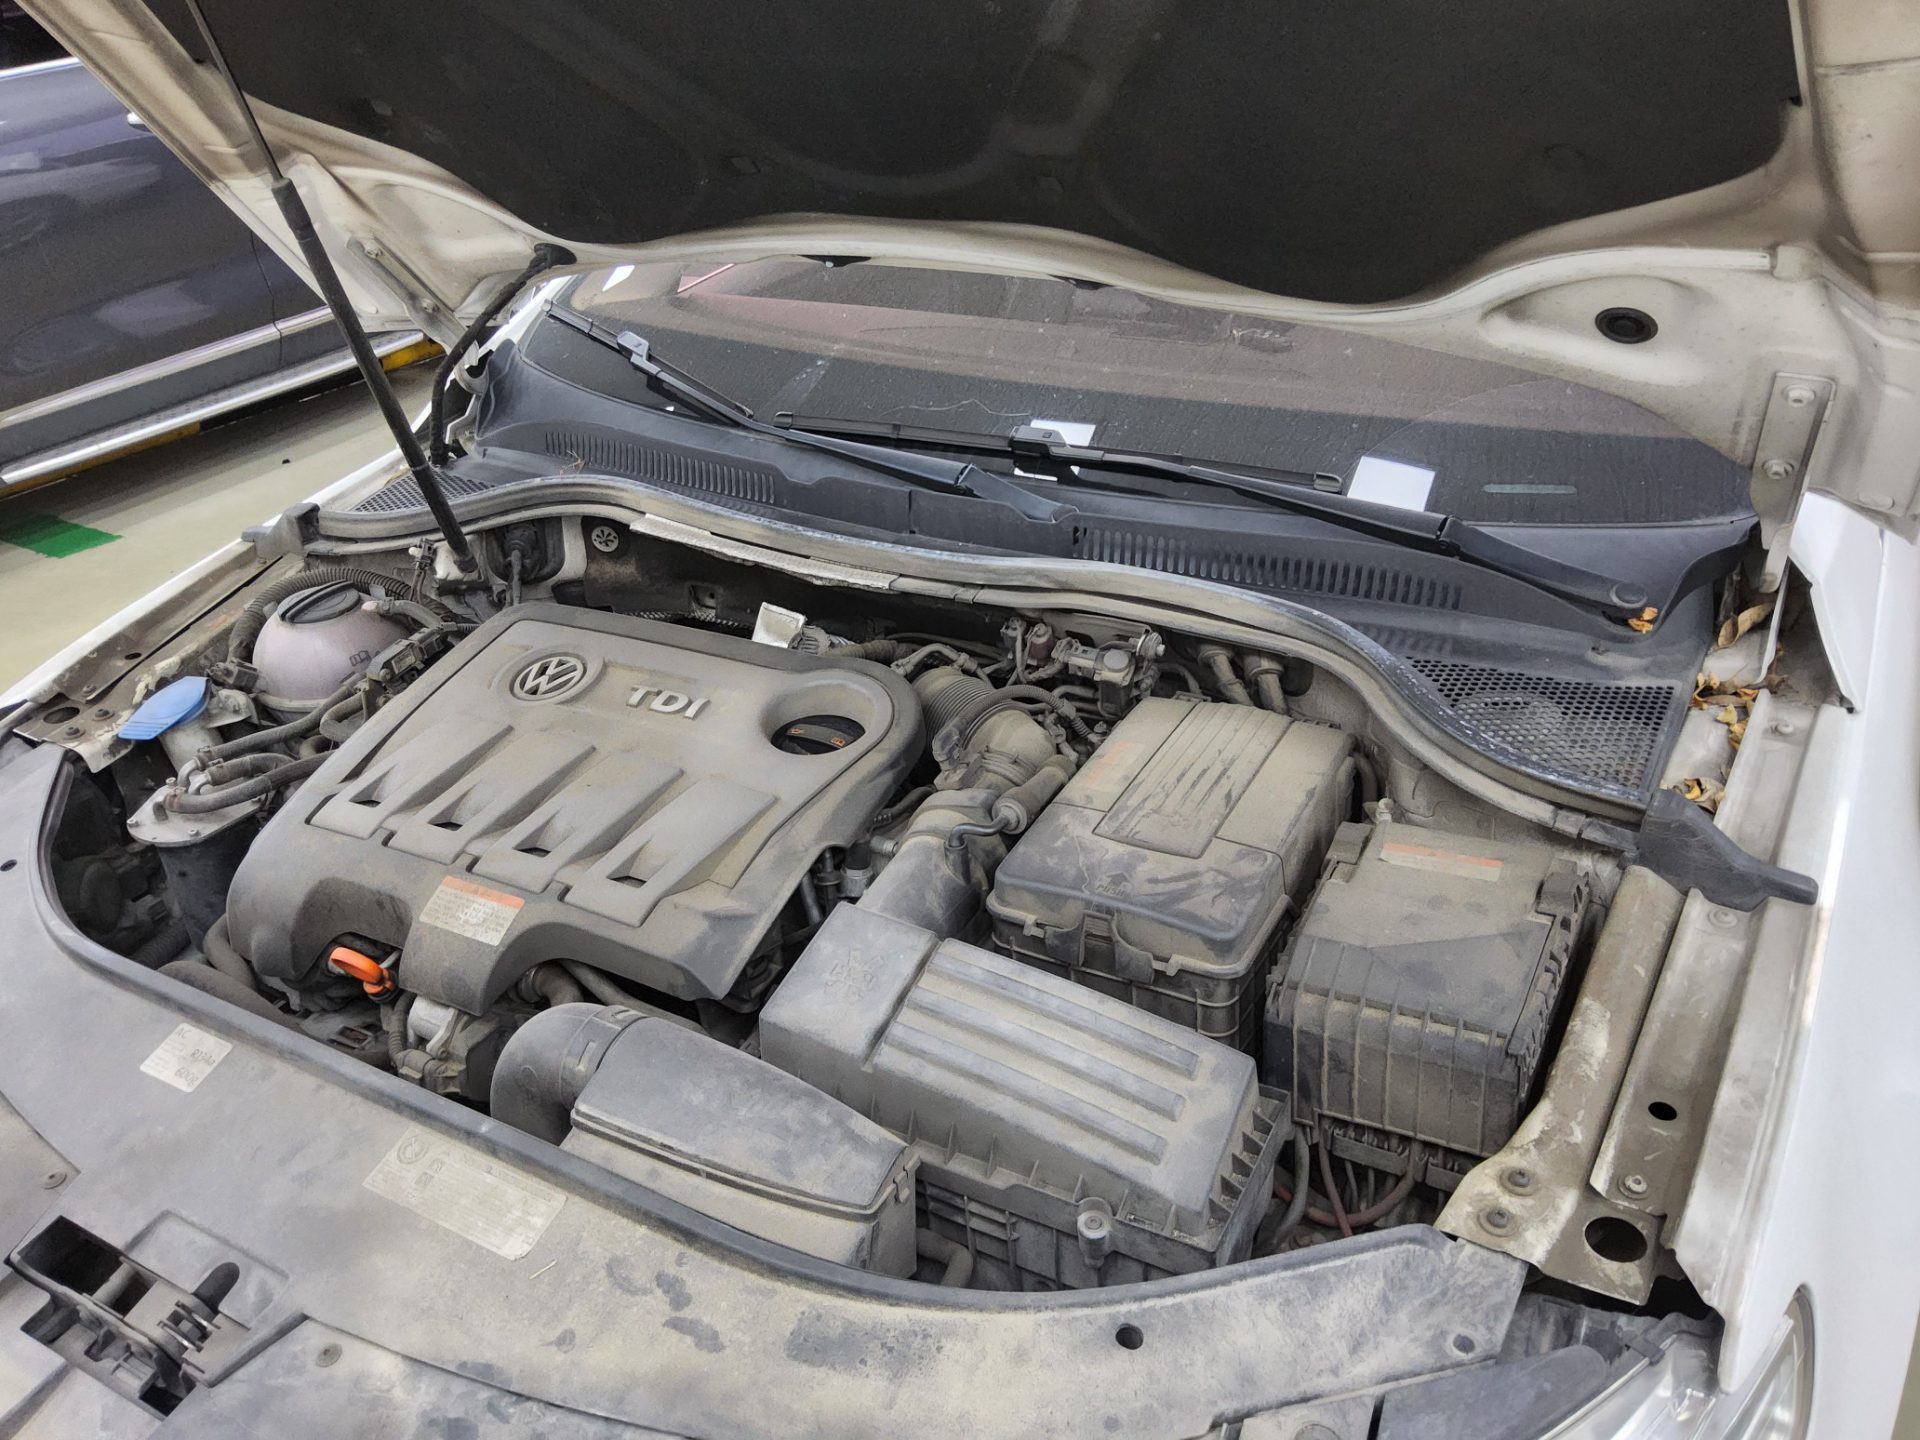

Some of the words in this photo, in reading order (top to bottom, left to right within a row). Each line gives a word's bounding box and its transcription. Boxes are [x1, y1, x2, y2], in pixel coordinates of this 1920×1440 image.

[626, 684, 711, 720] TDI
[1095, 884, 1126, 897] PUSH
[175, 1028, 192, 1039] AC
